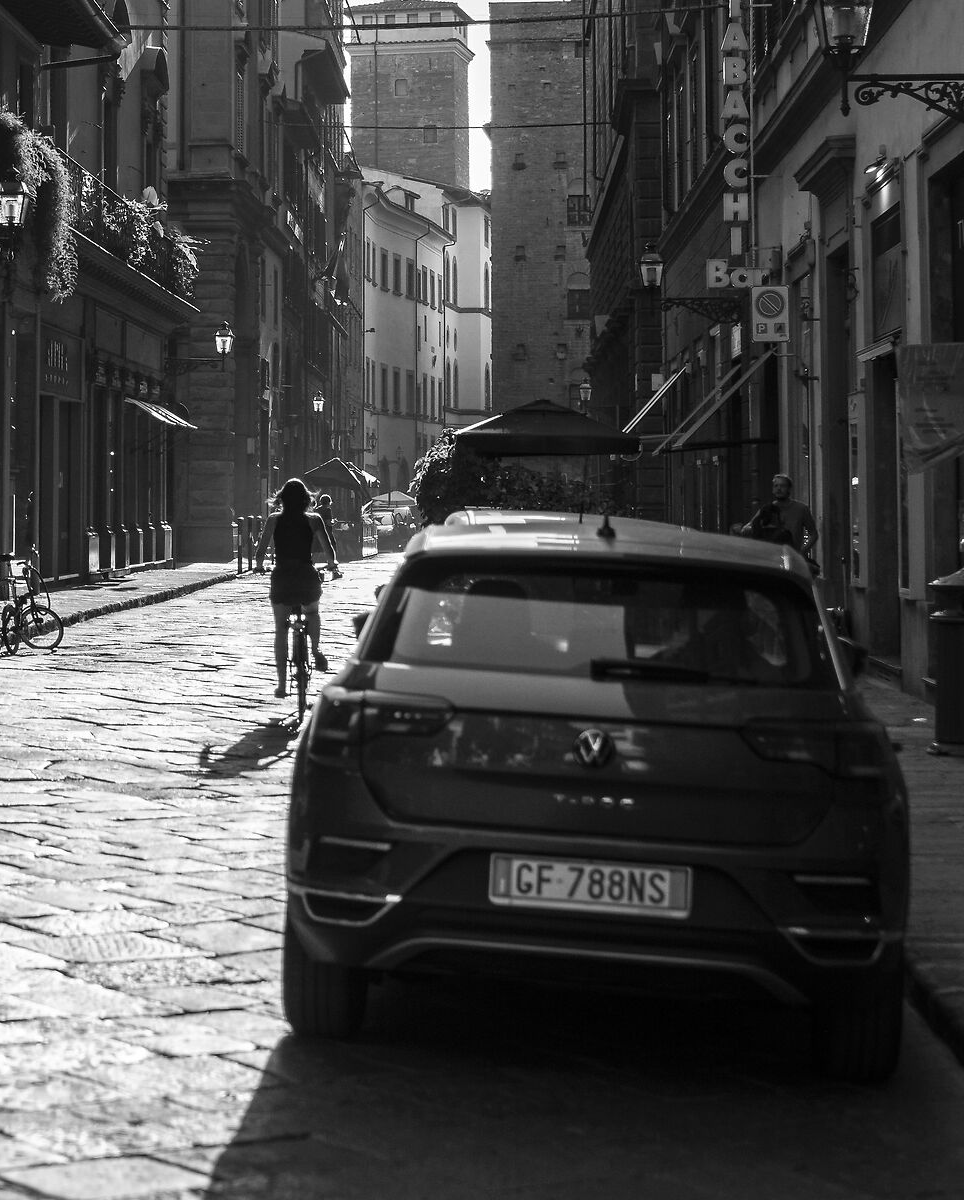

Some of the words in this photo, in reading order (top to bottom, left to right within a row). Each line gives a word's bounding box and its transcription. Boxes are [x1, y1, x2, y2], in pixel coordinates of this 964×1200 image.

[706, 259, 771, 289] Bar
[516, 863, 554, 896] GF
[566, 865, 667, 905] 788NS
